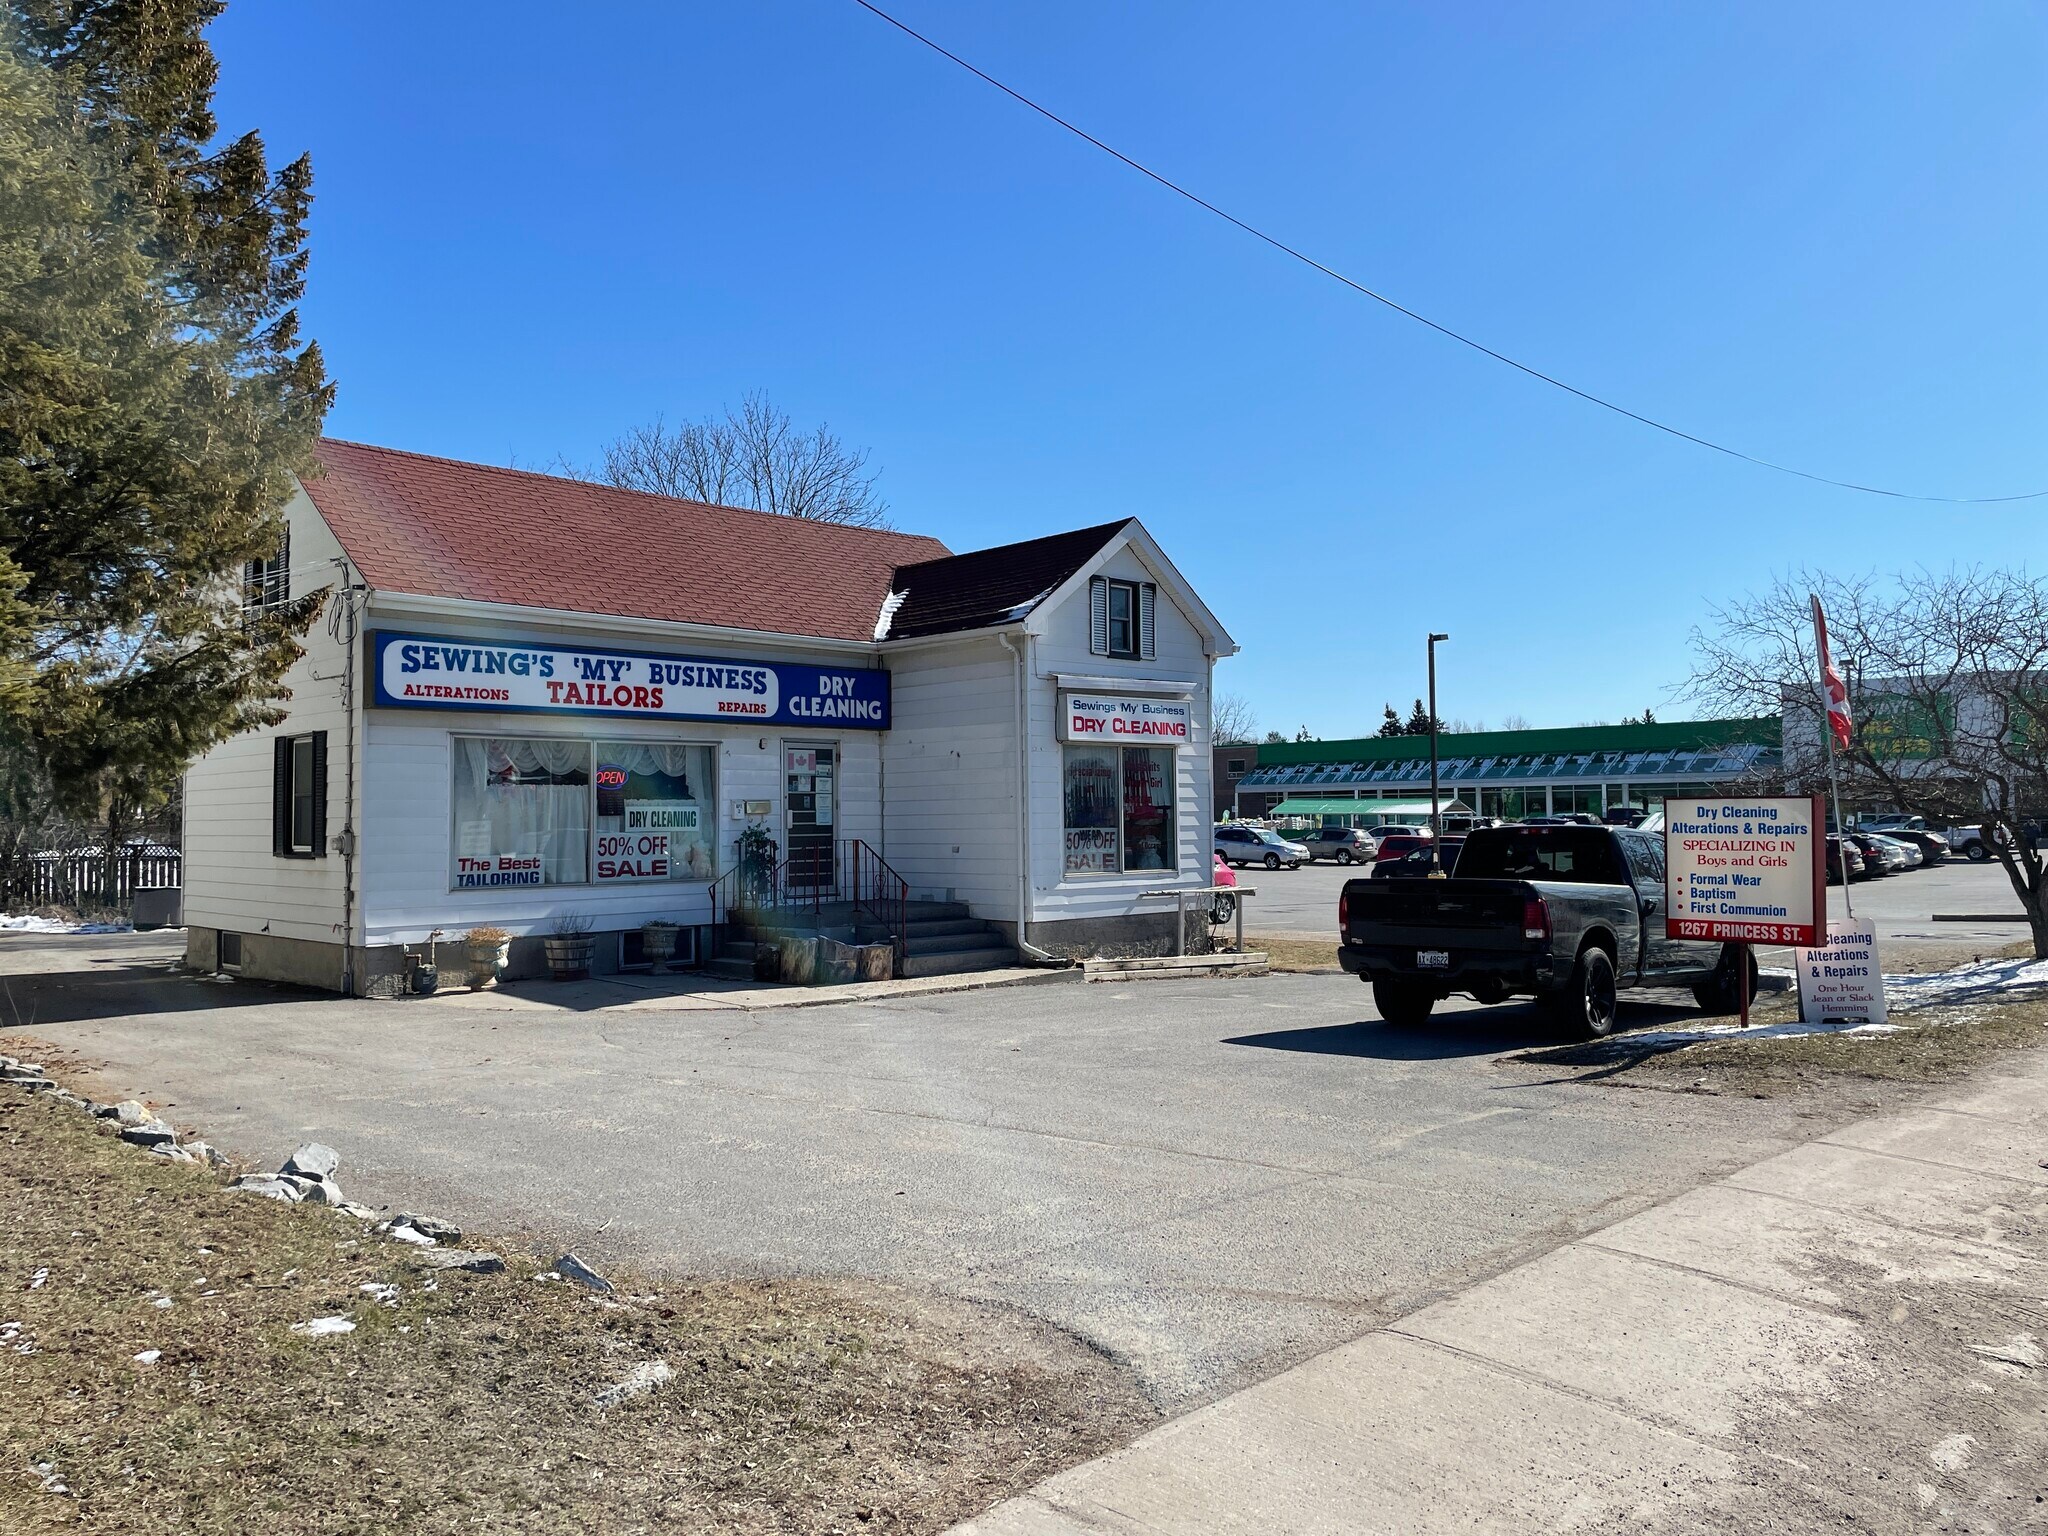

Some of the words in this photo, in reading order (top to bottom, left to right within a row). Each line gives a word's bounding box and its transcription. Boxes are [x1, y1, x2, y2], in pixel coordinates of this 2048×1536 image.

[401, 644, 554, 678] SEWING'S
[649, 662, 768, 695] BUSINESS
[403, 684, 510, 701] ALTERATIONS
[819, 675, 856, 697] DRY
[546, 681, 664, 709] TAILORS
[717, 701, 767, 714] REPAIRS
[788, 695, 882, 720] CLEANING
[1073, 700, 1116, 713] Sewings
[1142, 703, 1185, 716] Business
[1073, 716, 1107, 733] DRY
[1112, 717, 1186, 737] CLEANING
[596, 771, 625, 784] OPEN
[629, 811, 648, 828] DRY
[651, 810, 697, 828] CLEANING
[1696, 806, 1717, 820] Dry
[1722, 806, 1778, 820] Cleaning
[1671, 822, 1739, 835] Alterations
[1743, 823, 1753, 835] &
[1758, 823, 1808, 837] Repairs
[598, 836, 634, 857] 50%
[637, 836, 668, 856] OFF
[1066, 832, 1092, 849] 50%
[1093, 831, 1116, 849] OFF
[1683, 840, 1776, 852] SPECIALIZING
[1780, 841, 1796, 852] IN
[458, 858, 491, 872] The
[498, 857, 541, 870] Best
[1697, 854, 1727, 867] Boys
[1731, 854, 1754, 867] and
[1759, 855, 1788, 867] Girls
[598, 859, 668, 878] SALE
[457, 871, 540, 887] TAILORING
[1690, 873, 1728, 886] Formal
[1732, 874, 1762, 887] Wear
[1690, 887, 1736, 901] Baptism
[1691, 902, 1717, 915] First
[1720, 903, 1787, 917] Communion
[1678, 921, 1709, 936] 1267
[1713, 923, 1778, 940] PRINCESS
[1782, 926, 1803, 942] ST.
[1807, 949, 1870, 962] Alterations
[1811, 966, 1820, 978] &
[1824, 965, 1868, 979] Repairs
[1818, 984, 1837, 993] One
[1840, 983, 1865, 992] Hour
[1811, 994, 1834, 1003] Jean
[1836, 995, 1846, 1003] or
[1849, 993, 1875, 1003] Slack
[1822, 1004, 1869, 1013] Hemming
